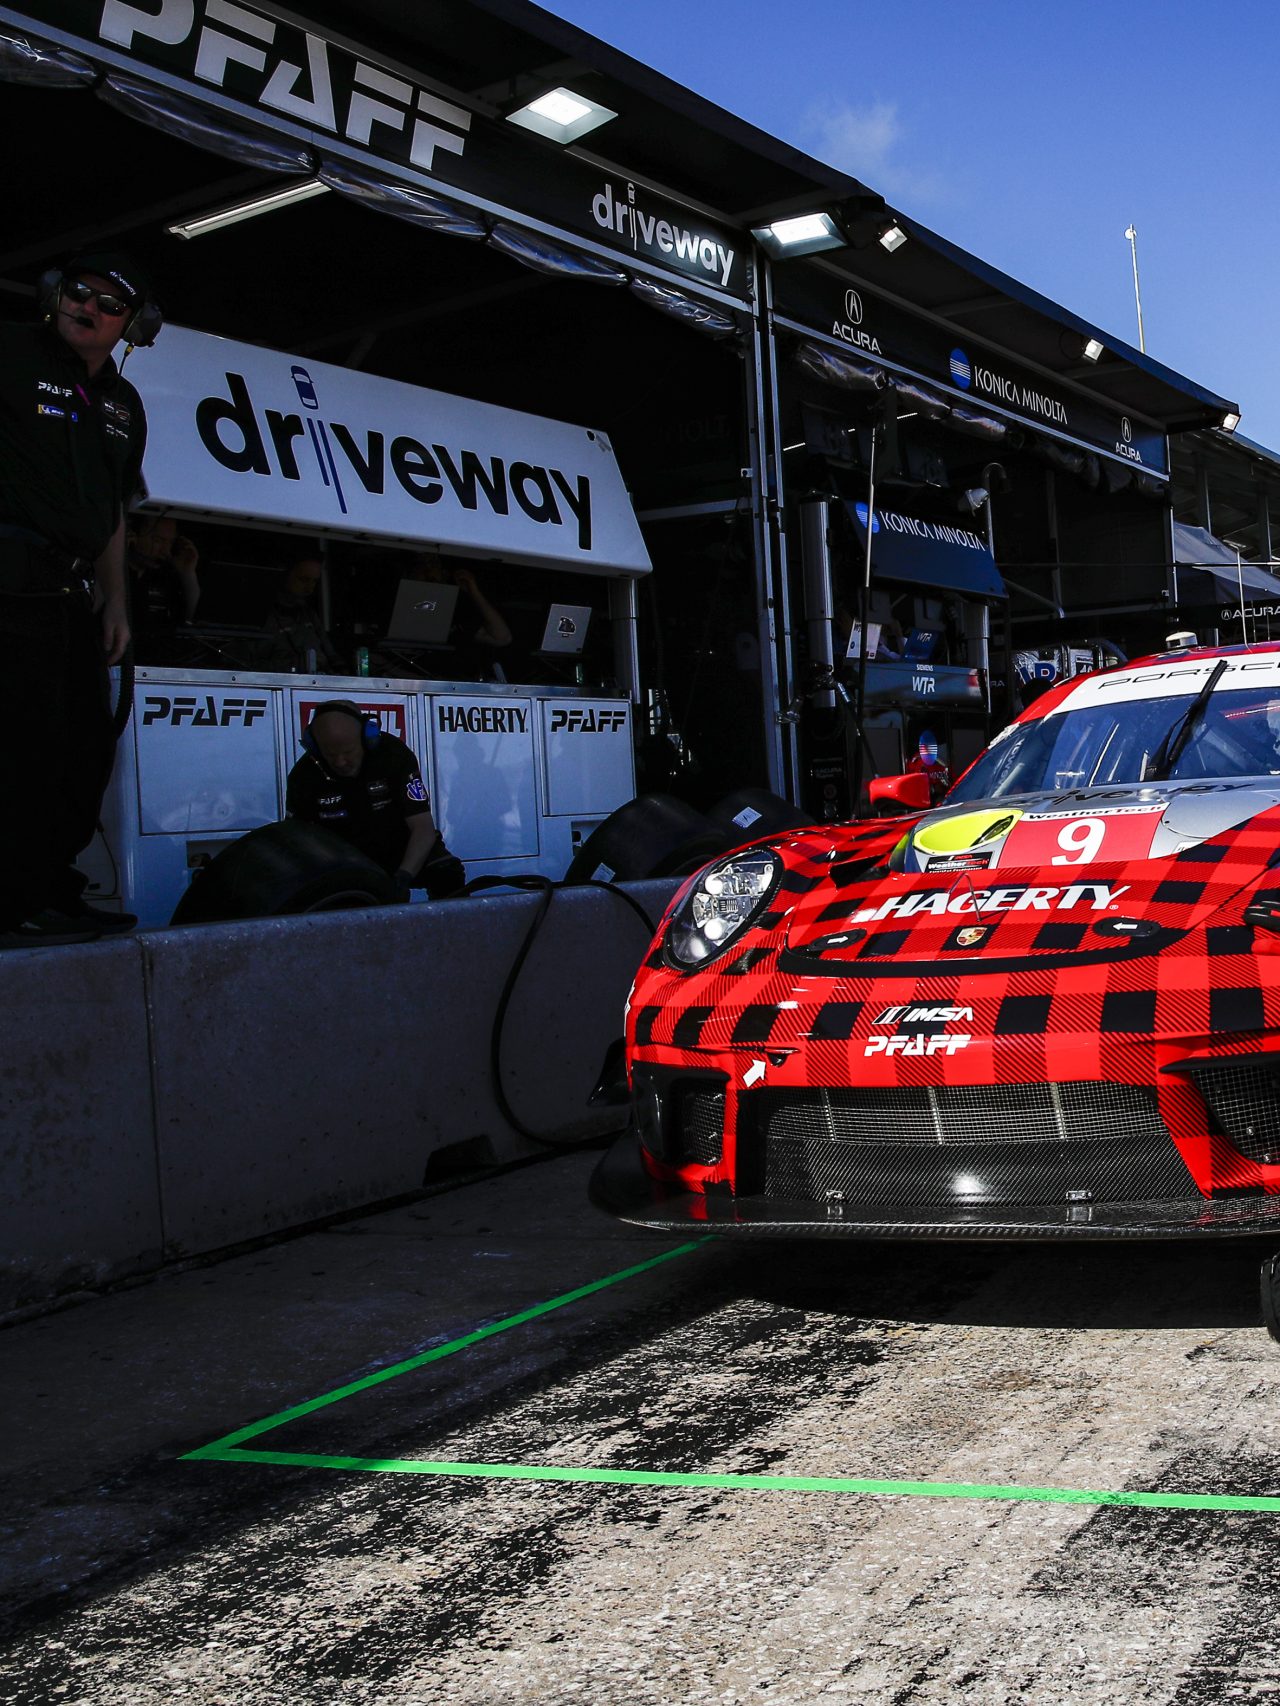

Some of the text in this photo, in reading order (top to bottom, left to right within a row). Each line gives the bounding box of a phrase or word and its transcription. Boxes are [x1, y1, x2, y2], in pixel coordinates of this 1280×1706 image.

[99, 0, 471, 171] PFAFF
[592, 182, 735, 287] driveway
[832, 320, 882, 355] ACURA
[974, 365, 1068, 425] KONICA MINOLTA
[195, 365, 593, 551] driveway
[1115, 441, 1143, 463] ACURA
[879, 510, 986, 552] KONICA MINOLTA
[911, 676, 935, 694] WTR
[142, 696, 268, 728] PFAFF
[550, 708, 626, 733] PFAFF
[1028, 804, 1165, 820] WeatherTech
[1051, 818, 1107, 866] 9
[903, 1007, 973, 1022] IMSA
[864, 1033, 972, 1057] PFAFF
